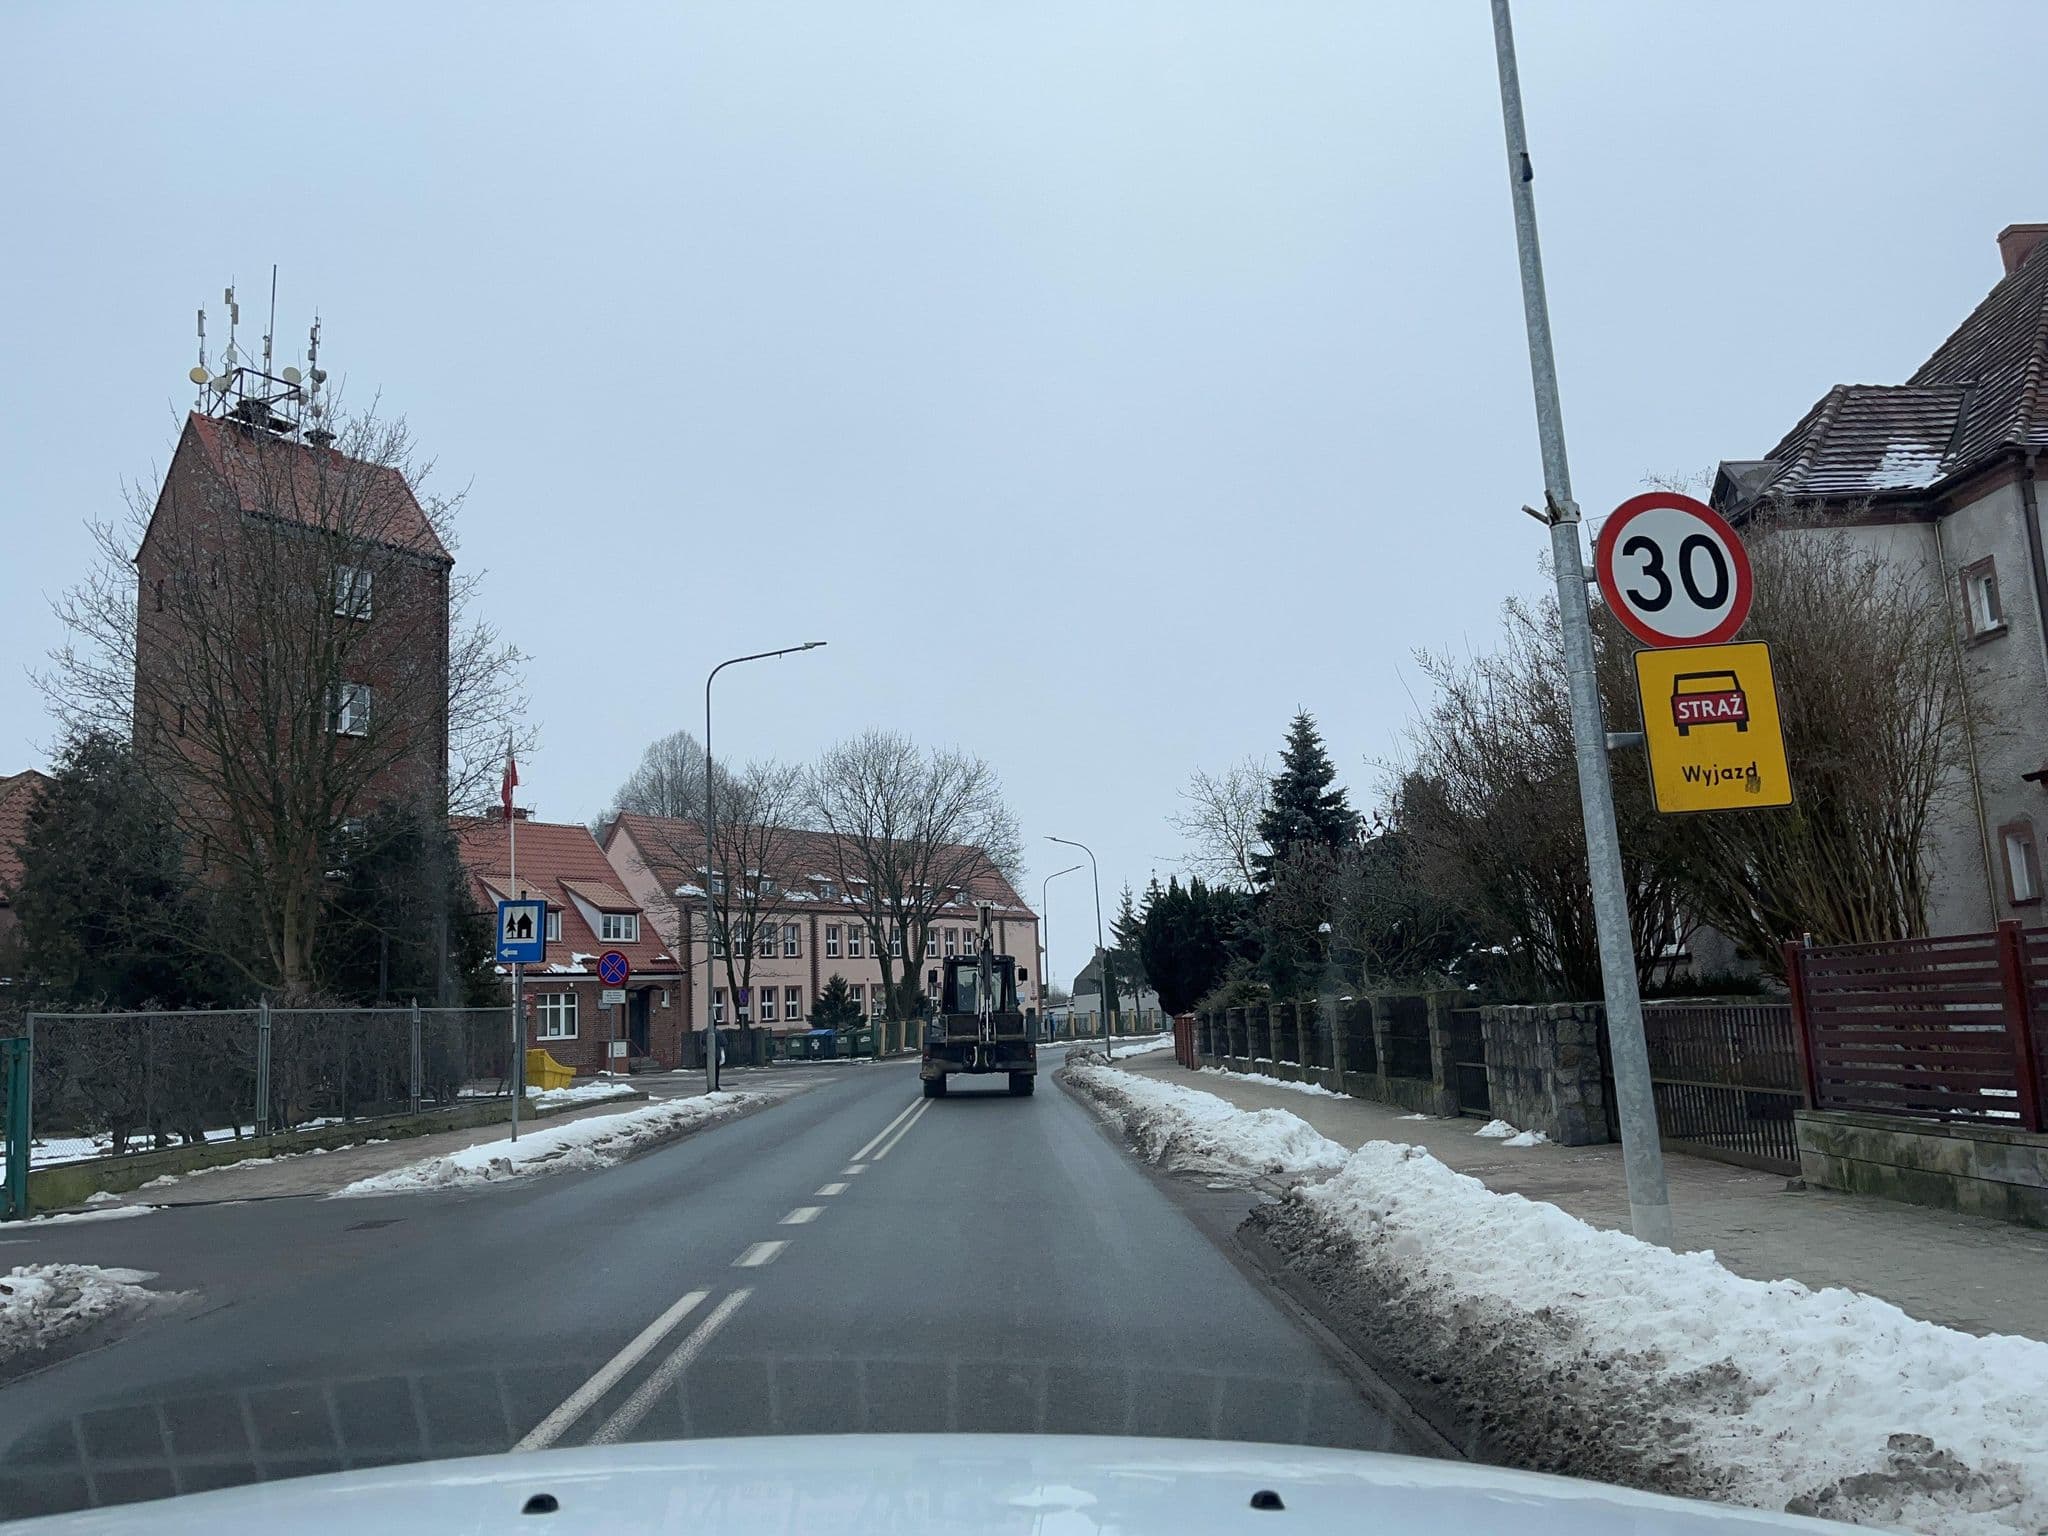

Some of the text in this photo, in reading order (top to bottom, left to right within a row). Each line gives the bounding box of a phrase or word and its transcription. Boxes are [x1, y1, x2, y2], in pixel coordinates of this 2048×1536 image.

[1622, 534, 1729, 612] 30
[1678, 694, 1743, 719] STRAŻ
[1681, 761, 1757, 787] Wyjazd
